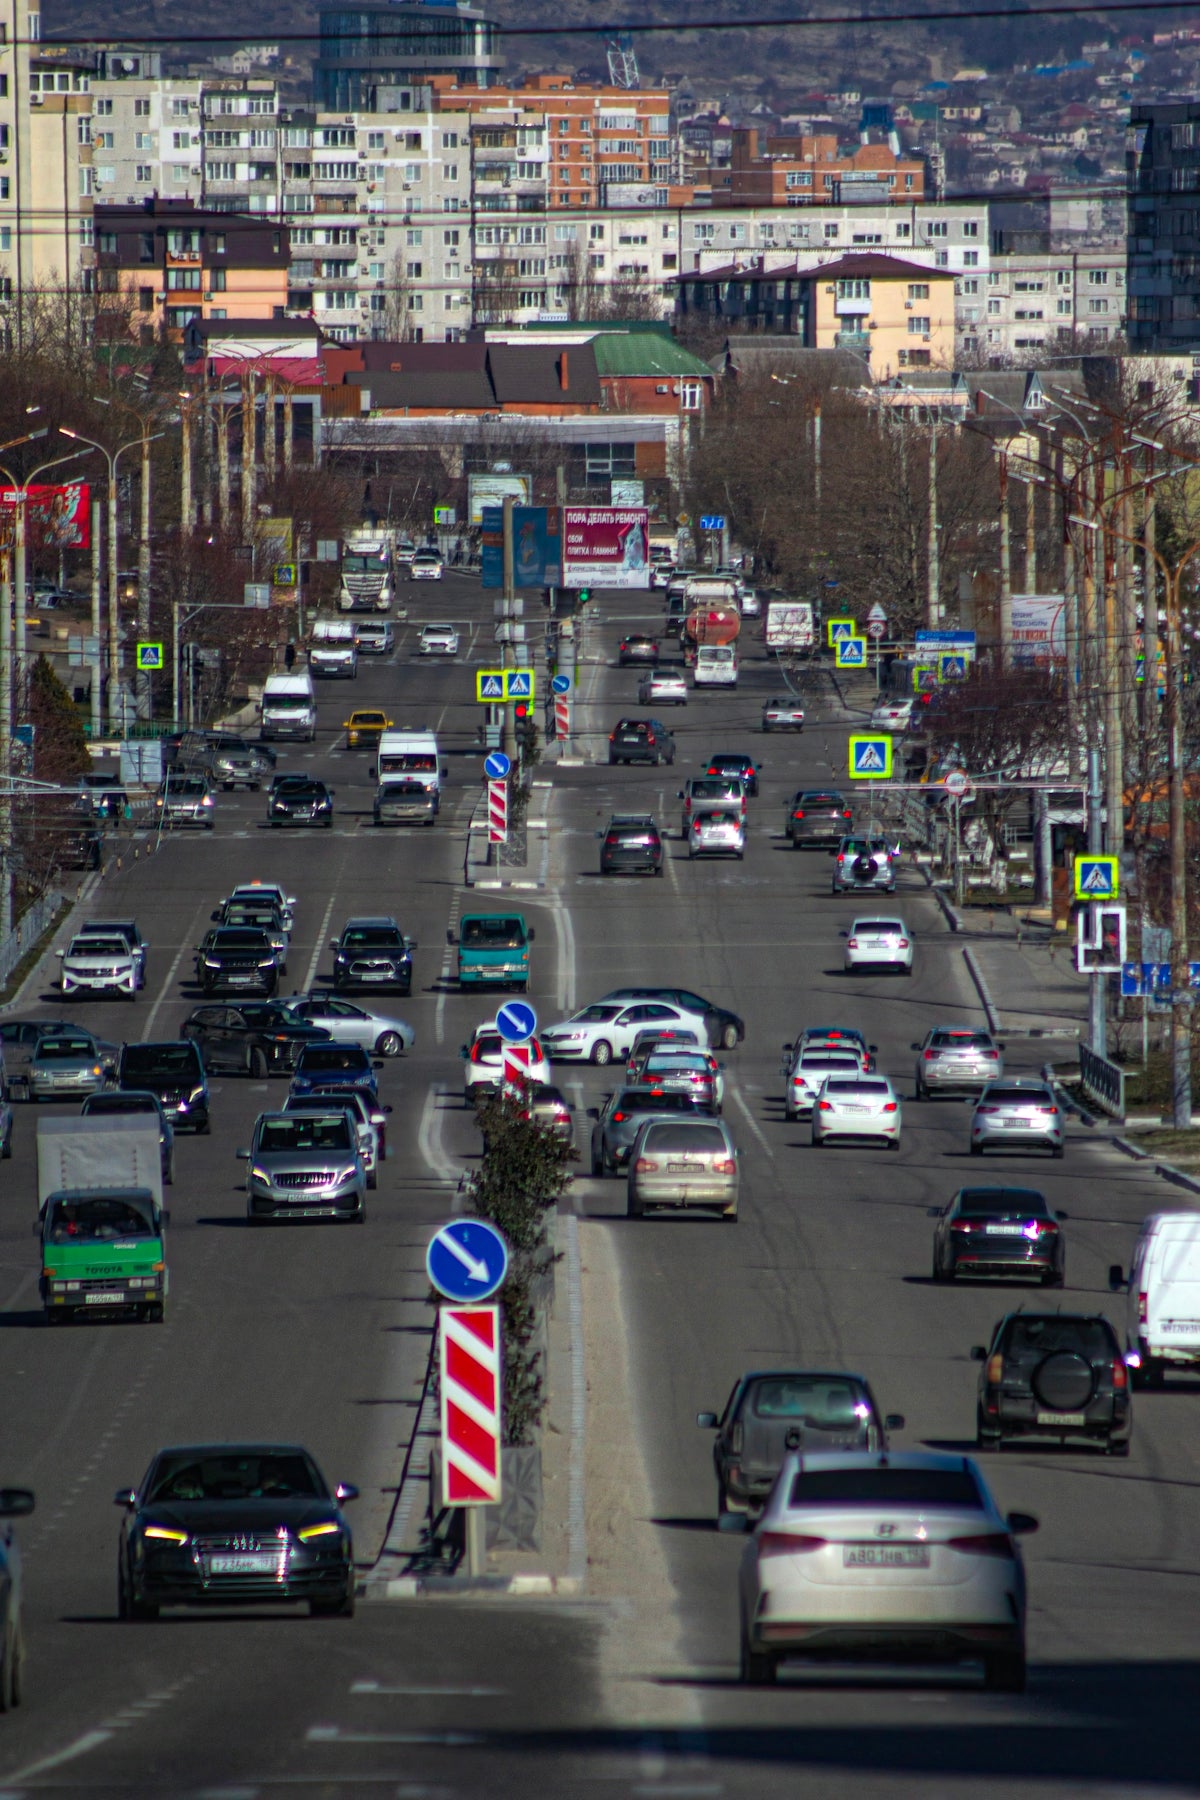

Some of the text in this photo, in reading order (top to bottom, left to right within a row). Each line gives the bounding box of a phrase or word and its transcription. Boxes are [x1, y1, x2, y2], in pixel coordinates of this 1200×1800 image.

[567, 512, 646, 525] ПОРА ДЕЛАТЬ РЕМОНТ!
[567, 534, 583, 543] ОБОИ
[567, 546, 618, 556] ПЛИТКА ЛАМИНАТ
[85, 1265, 123, 1274] TOYOTA
